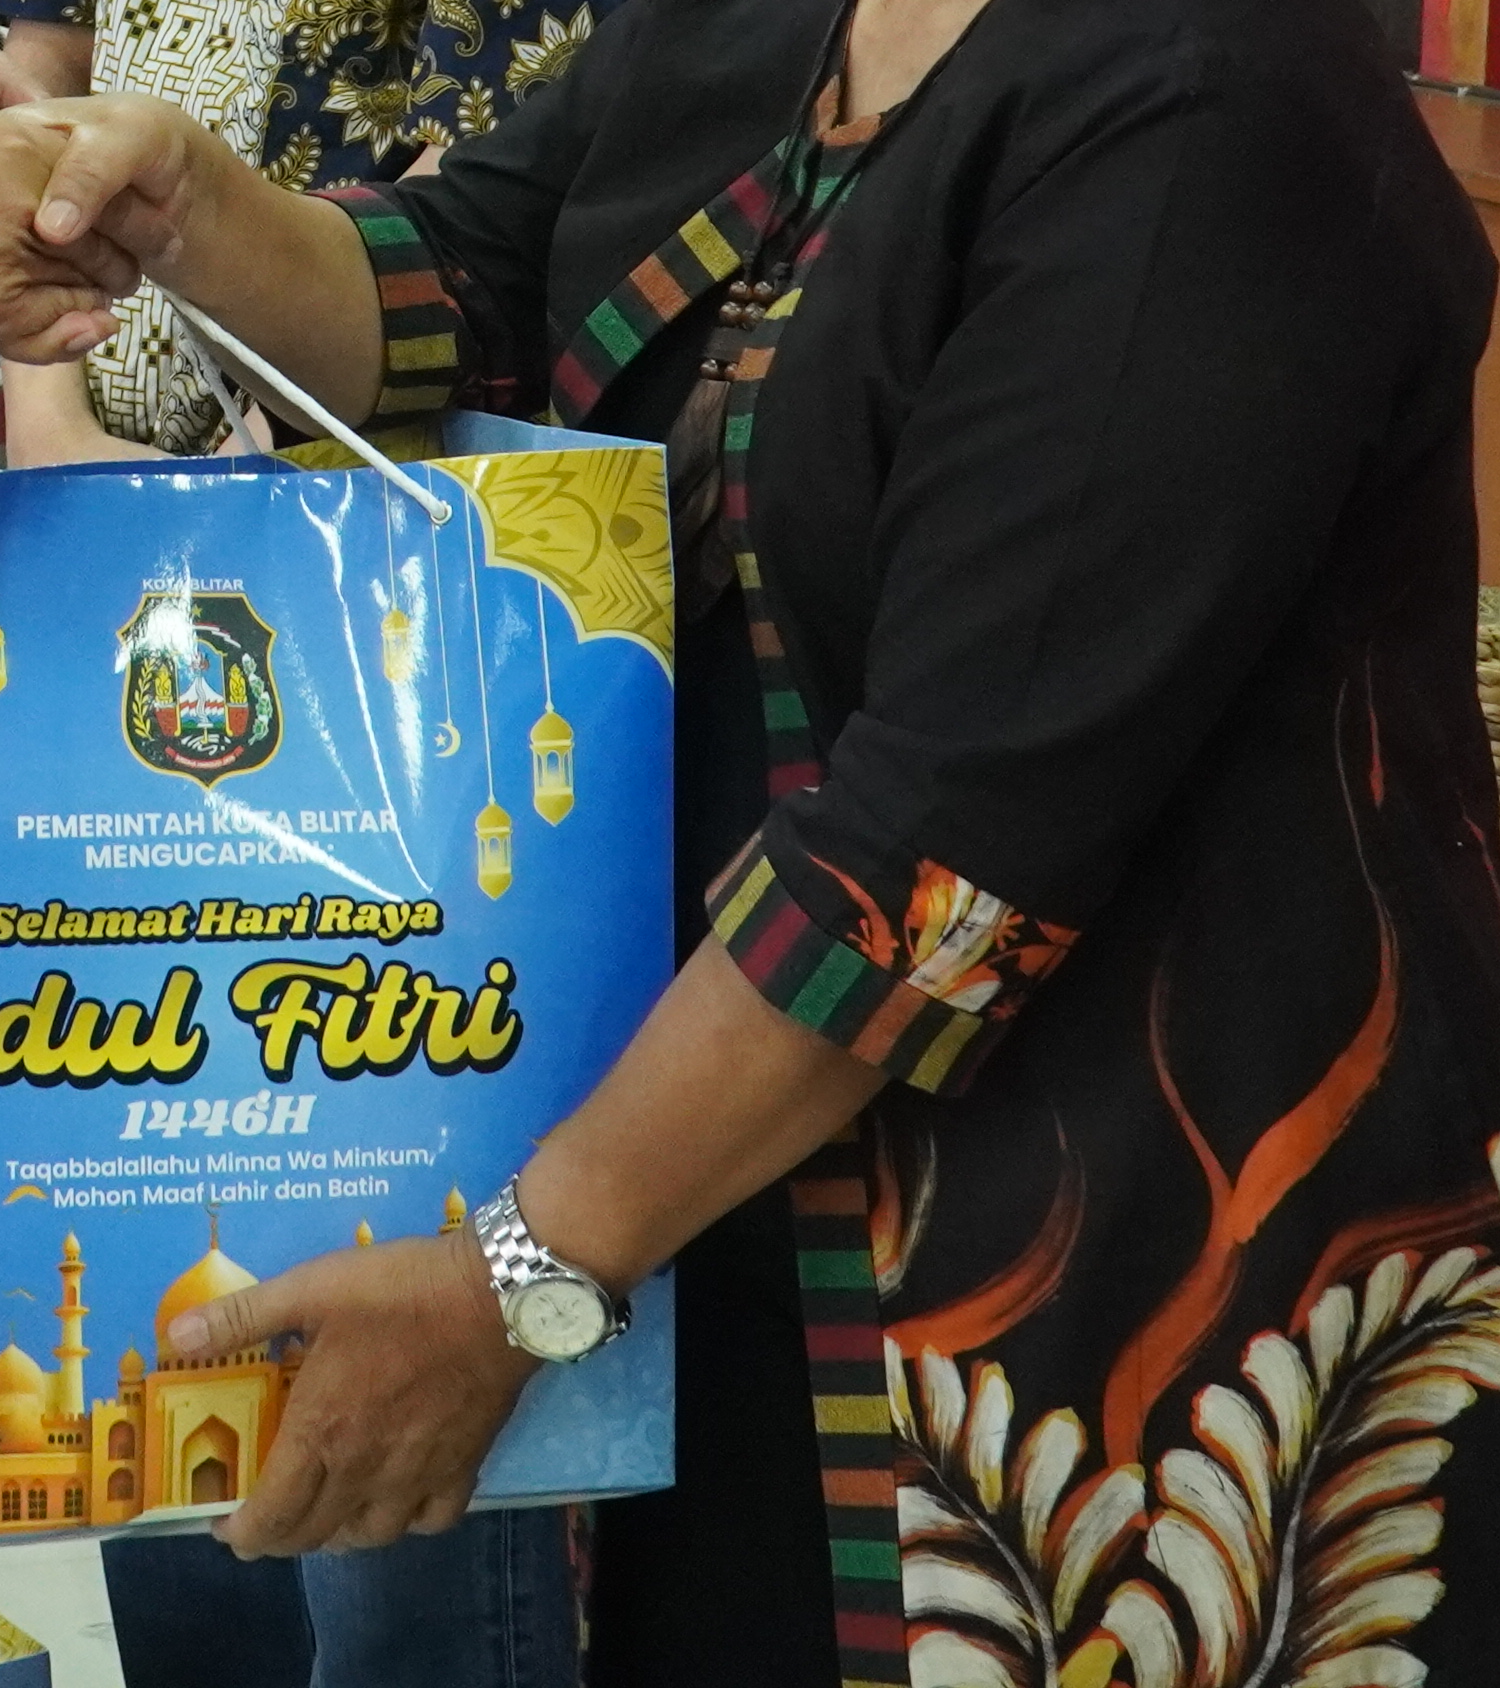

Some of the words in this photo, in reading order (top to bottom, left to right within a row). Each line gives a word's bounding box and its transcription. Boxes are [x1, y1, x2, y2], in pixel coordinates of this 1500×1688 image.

[190, 578, 245, 591] BLITAR
[17, 811, 205, 839] PEMERINTAH
[300, 809, 401, 834] BLITAR
[195, 893, 317, 942] Hari
[314, 895, 444, 945] Raya
[229, 952, 524, 1082] Fitri
[118, 1088, 318, 1141] 1446H
[6, 1155, 200, 1185] Taqabbalallahu
[206, 1152, 281, 1174] Minna
[287, 1150, 327, 1171] Wa
[333, 1146, 436, 1170] Minkum,
[54, 1187, 137, 1209] Mohon
[143, 1182, 205, 1205] Maaf
[210, 1180, 268, 1203] Lahir
[274, 1177, 319, 1200] dan
[328, 1175, 390, 1197] Batin
